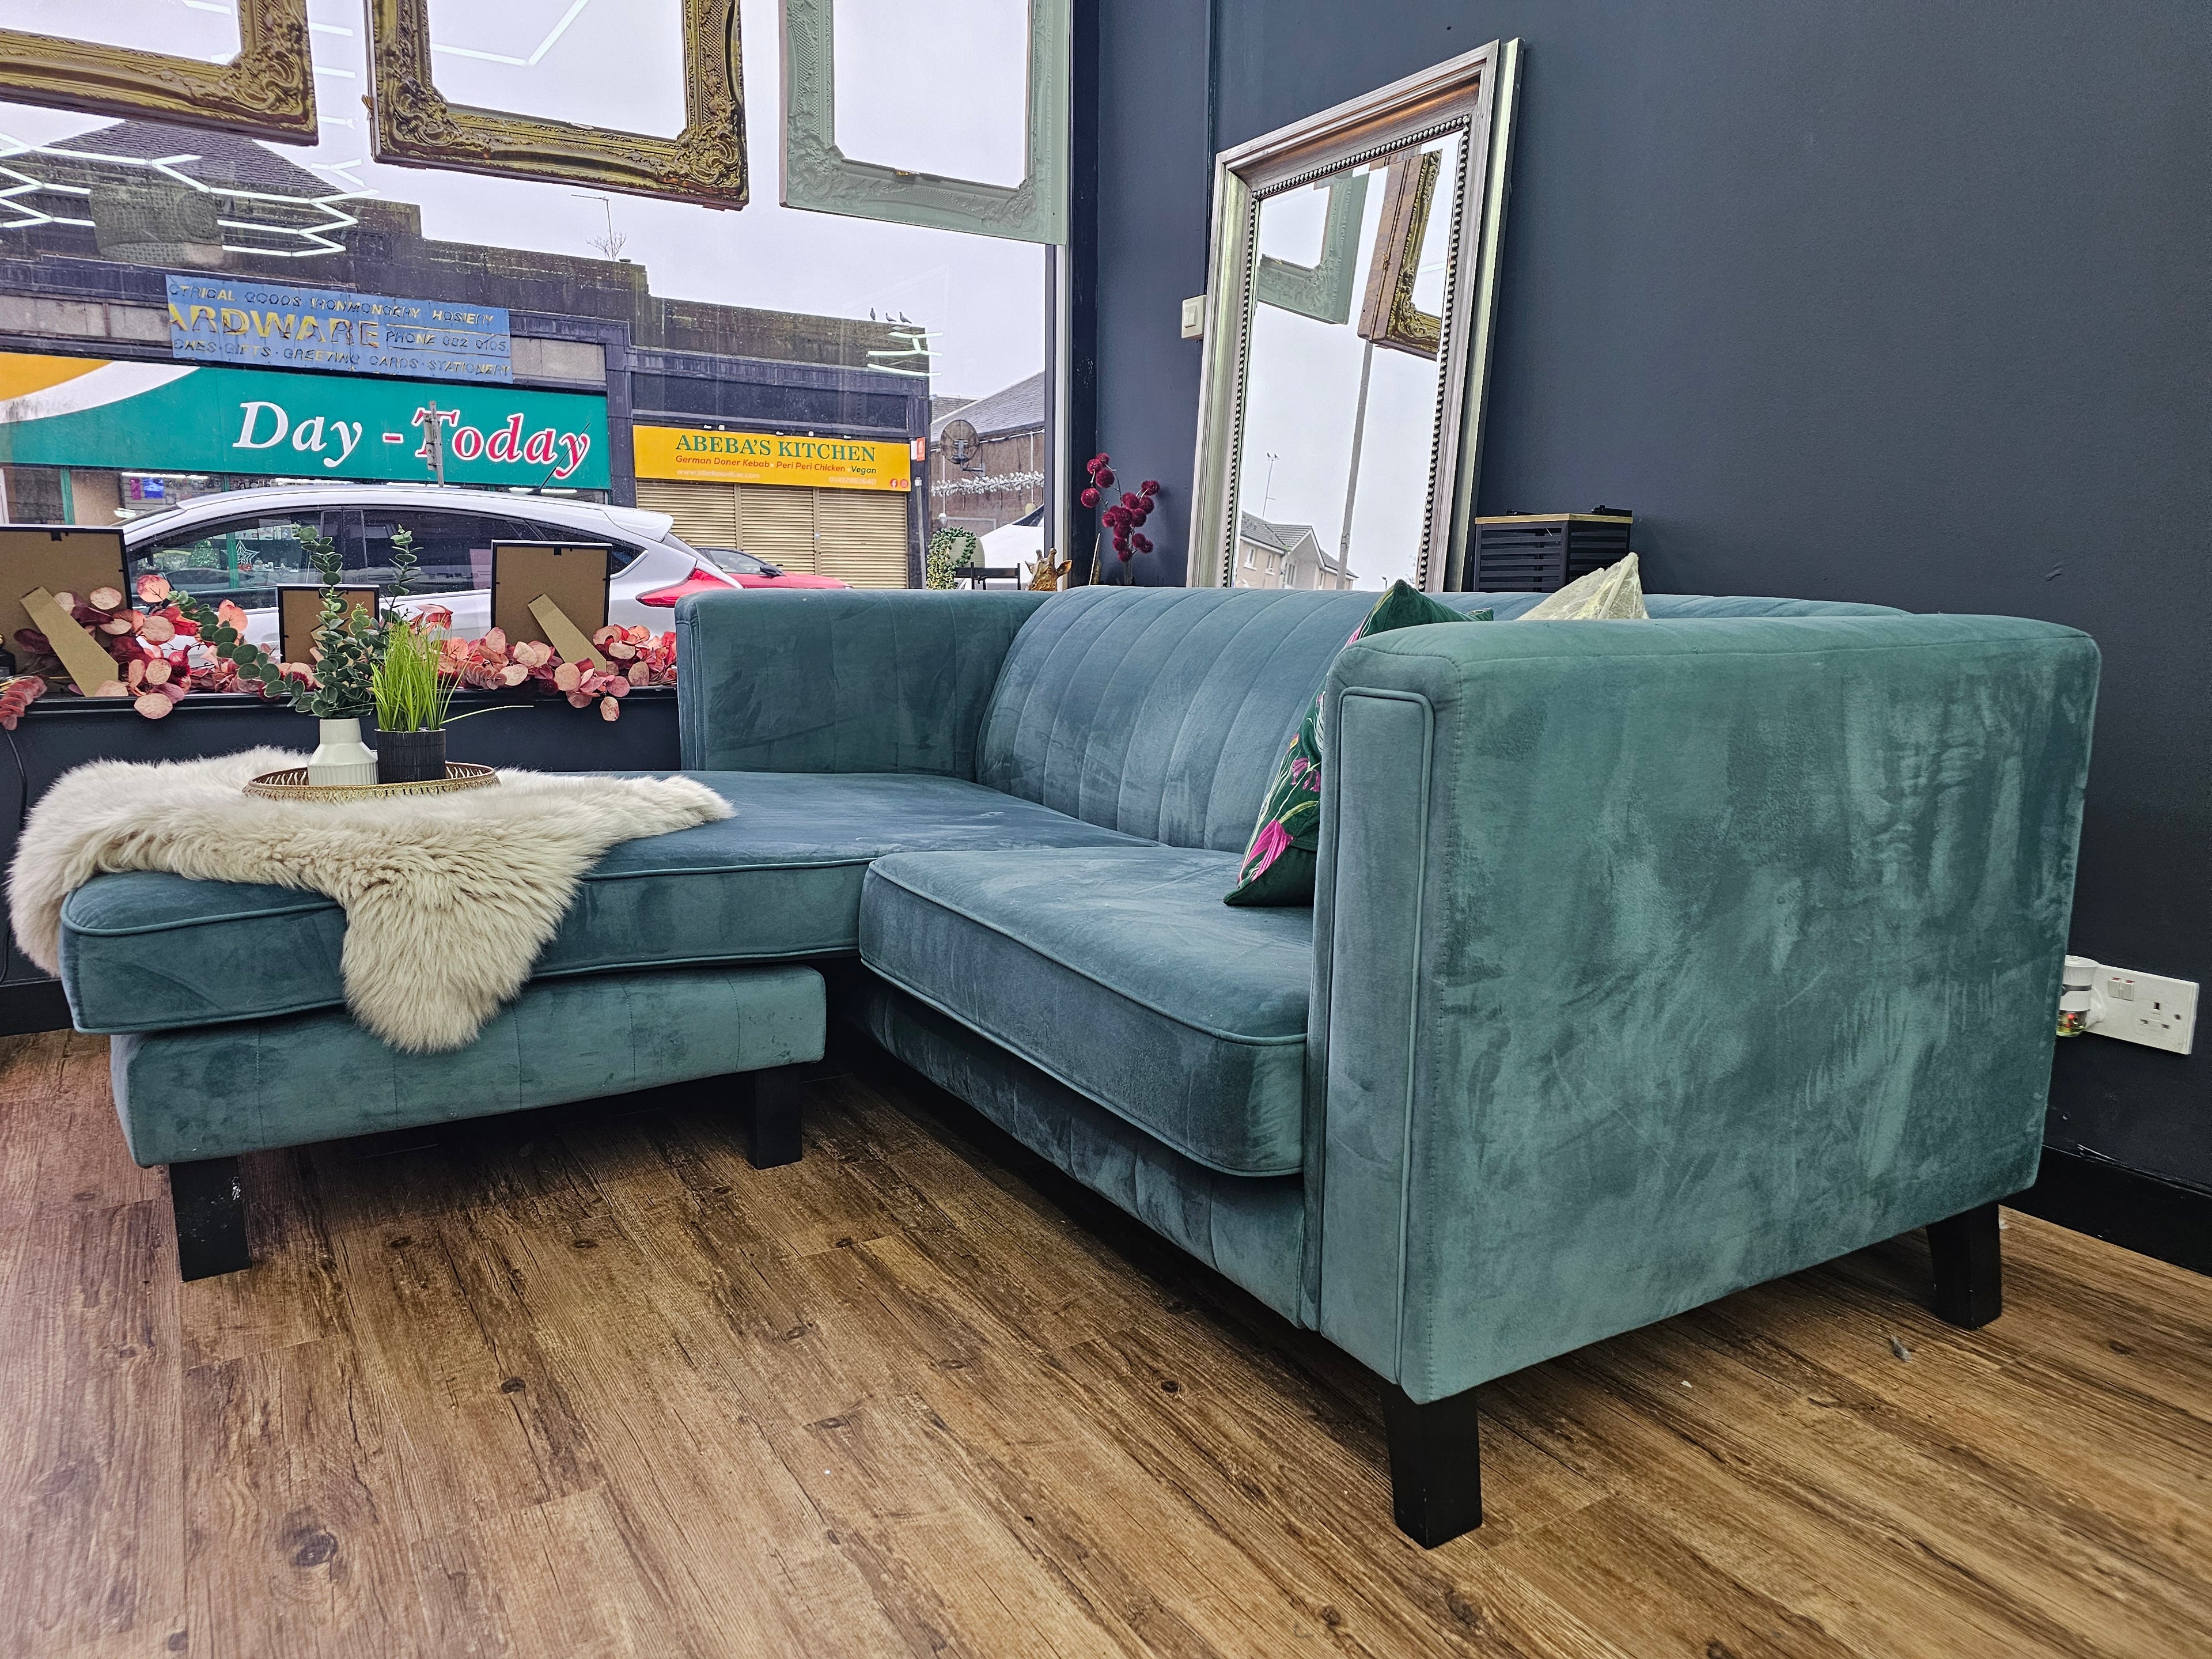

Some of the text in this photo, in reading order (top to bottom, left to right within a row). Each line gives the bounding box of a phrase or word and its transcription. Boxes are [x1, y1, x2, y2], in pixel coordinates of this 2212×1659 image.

[244, 291, 302, 306] GOODS
[386, 330, 437, 345] PHONE
[283, 348, 360, 365] GREETING
[369, 355, 419, 369] CARDS
[427, 359, 511, 376] STATIONERY
[232, 401, 363, 468] Day
[411, 407, 591, 480] Today
[675, 434, 876, 462] ABEBA'S KITCHEN
[676, 455, 877, 475] German Doner Kebab Peri Peri Chicken Vegan
